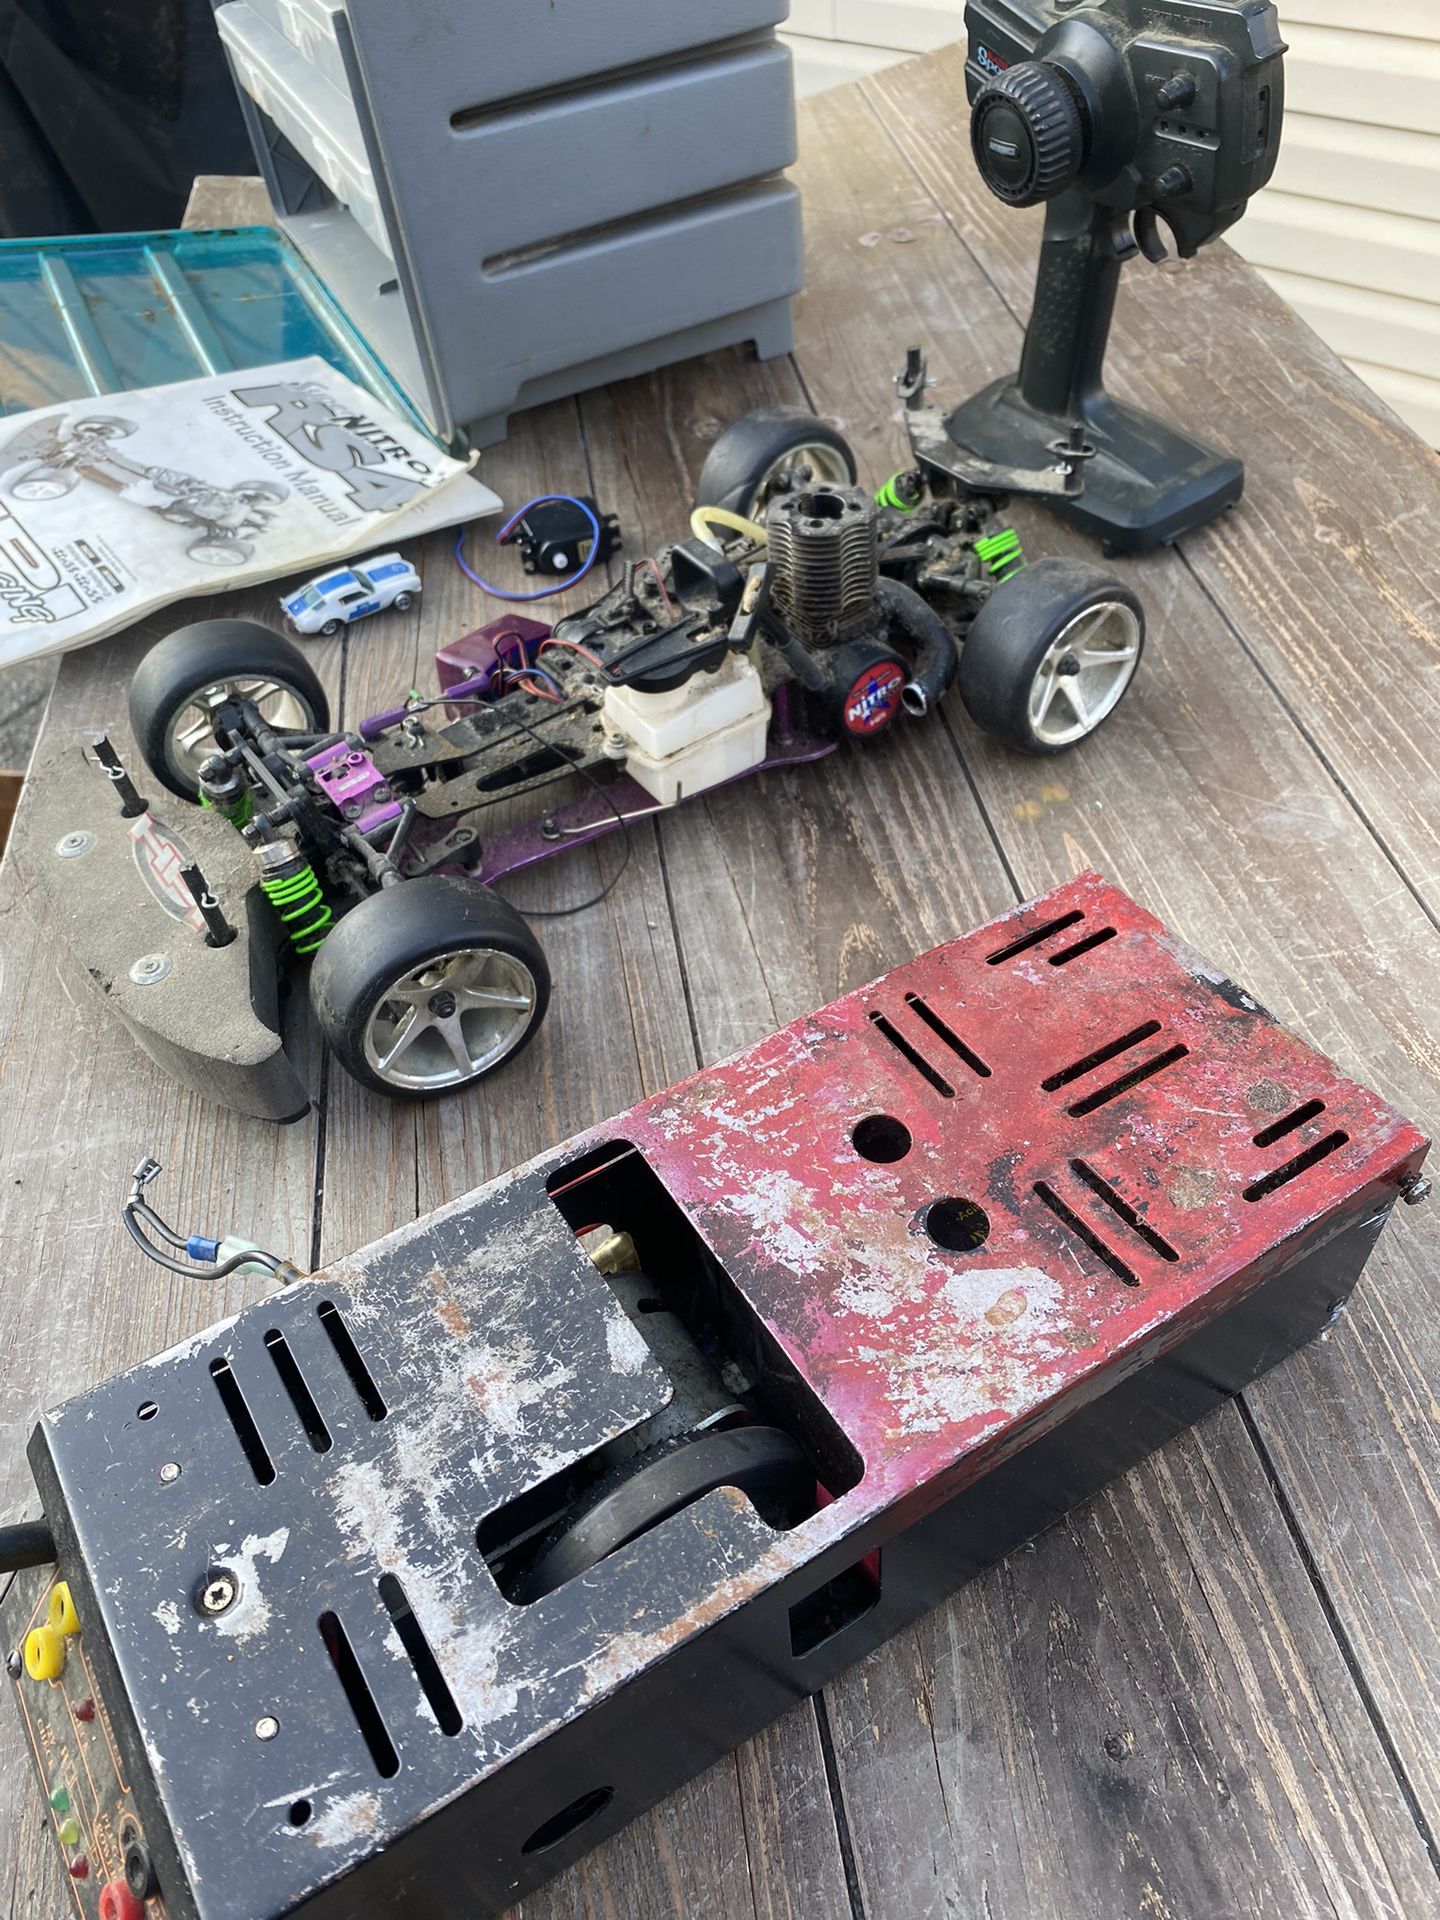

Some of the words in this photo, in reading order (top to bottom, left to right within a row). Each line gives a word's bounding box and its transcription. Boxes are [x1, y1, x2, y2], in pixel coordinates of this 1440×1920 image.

[202, 395, 293, 471] Instruction
[284, 469, 361, 528] Manual
[230, 383, 433, 513] RS4
[332, 414, 432, 475] NITRO
